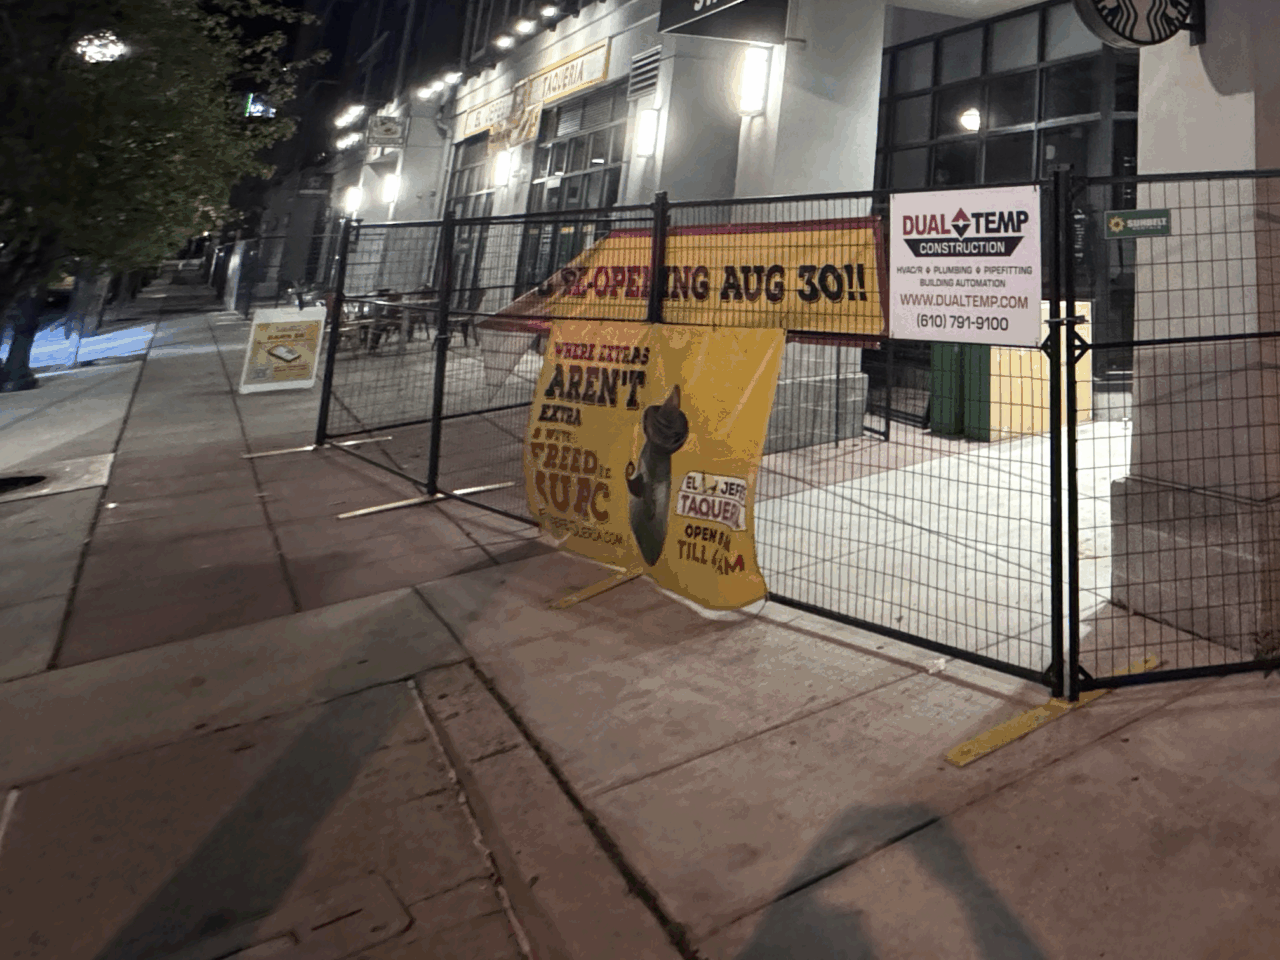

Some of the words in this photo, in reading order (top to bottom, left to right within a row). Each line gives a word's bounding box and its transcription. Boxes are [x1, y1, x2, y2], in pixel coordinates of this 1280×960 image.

[542, 59, 584, 98] TAQUERIA
[902, 214, 951, 235] DUAL
[971, 210, 1029, 234] TEMP
[919, 241, 1006, 254] CONSTRUCTION
[896, 266, 923, 274] HVAC/R
[933, 266, 973, 275] PLUMBING
[983, 266, 1033, 275] PIPEFITTING
[719, 264, 786, 303] AUG
[797, 263, 868, 304] 30!!
[919, 278, 954, 287] BUILDING
[955, 278, 1006, 288] AUTOMATION
[899, 293, 1029, 309] WWW.DUALTEMP.COM
[916, 313, 947, 329] (610)
[949, 315, 1009, 331] 791-9100
[543, 363, 647, 411] AREN'T
[537, 403, 582, 427] EXTRA
[685, 475, 699, 491] EL
[684, 523, 718, 543] OPEN
[677, 539, 708, 565] TILL
